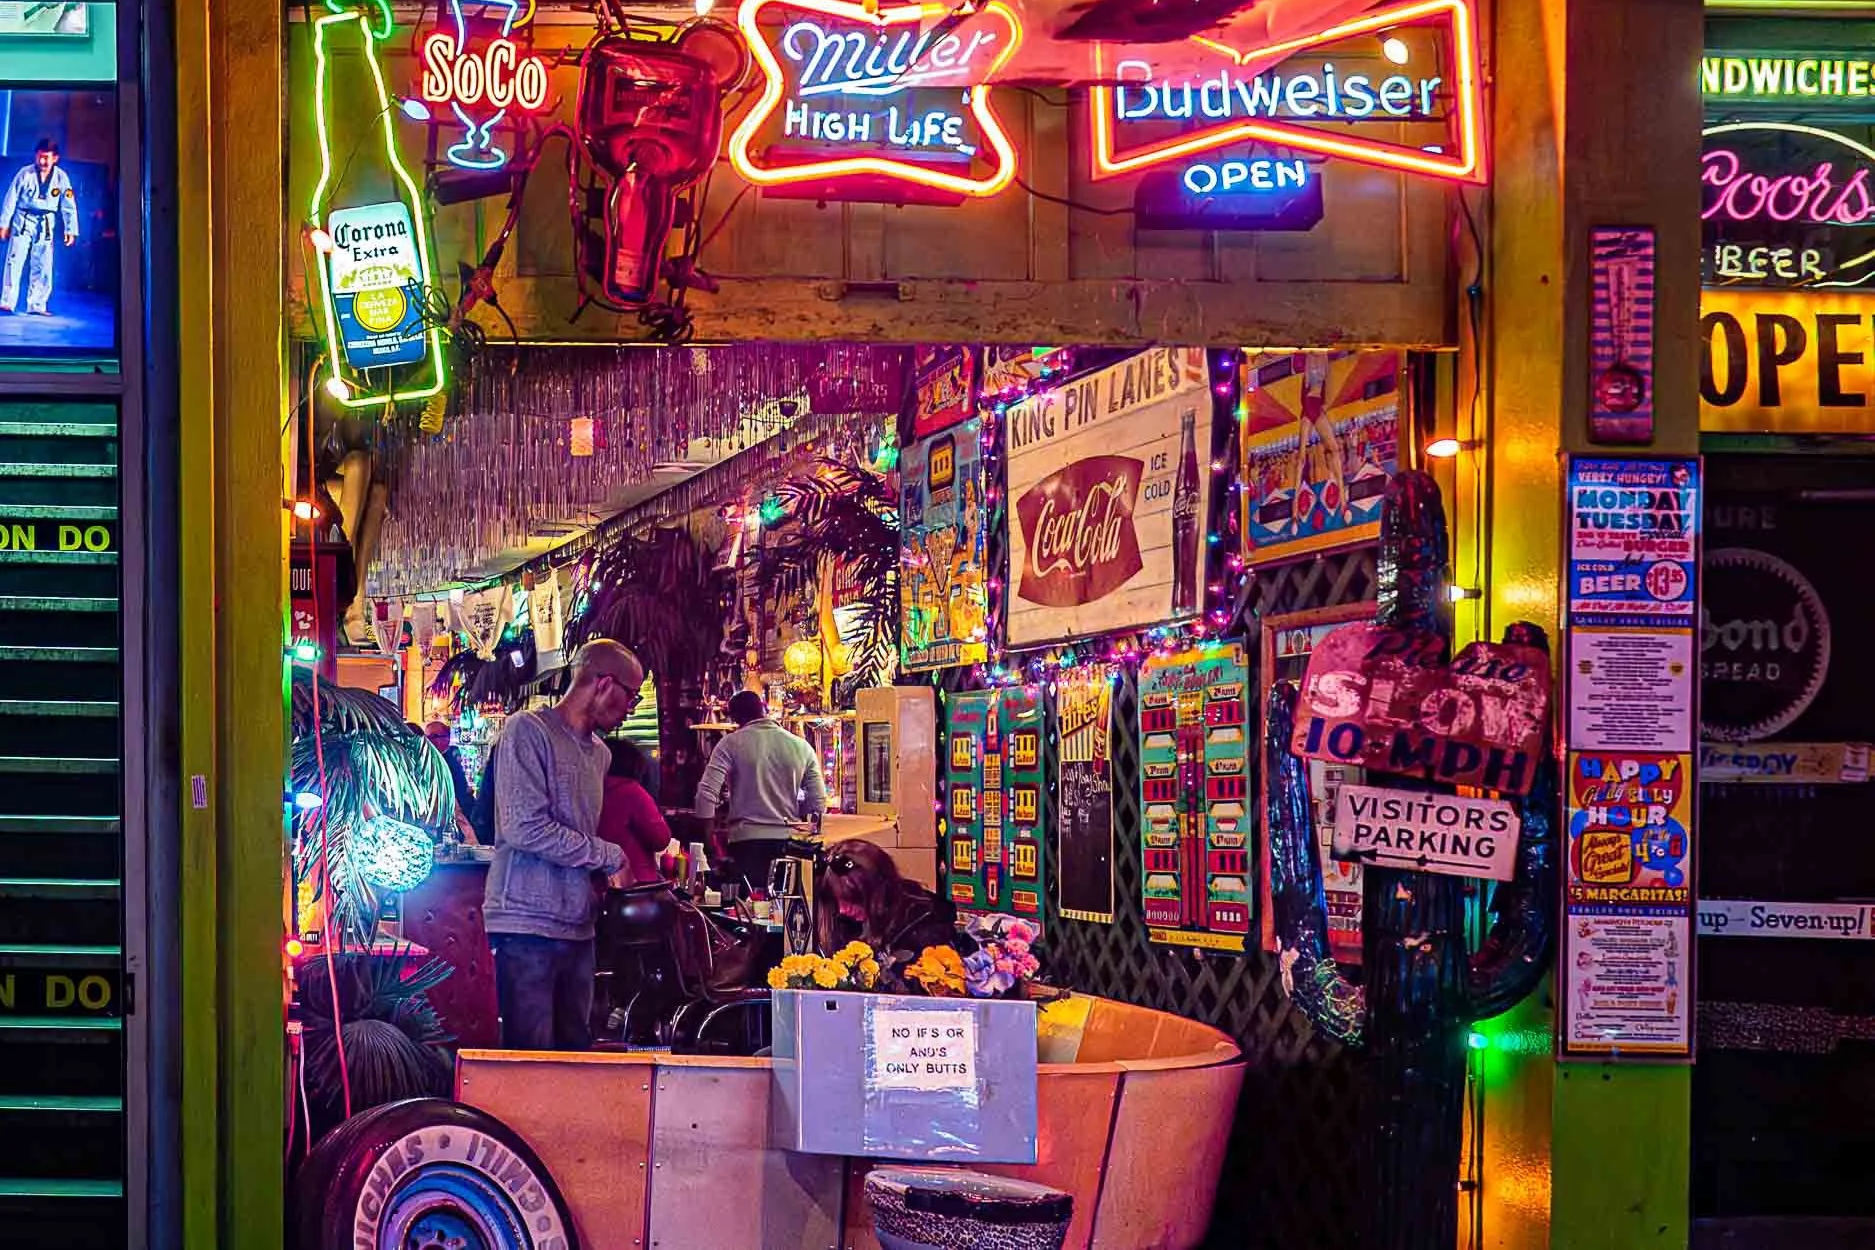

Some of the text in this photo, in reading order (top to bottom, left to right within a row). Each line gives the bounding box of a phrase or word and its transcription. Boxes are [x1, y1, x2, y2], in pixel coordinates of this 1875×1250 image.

[423, 33, 548, 110] SoCo
[783, 21, 997, 94] Miller
[1116, 60, 1442, 121] Budweiser
[1700, 57, 1875, 96] NDWICHE
[784, 100, 870, 143] HIGH
[1183, 159, 1307, 193] OPEN
[334, 220, 408, 251] Corona
[353, 246, 400, 262] Extra
[1715, 245, 1828, 279] BEER
[1699, 310, 1875, 408] OPE
[1011, 348, 1180, 450] KING PIN LANES
[1150, 453, 1168, 471] ICE
[1144, 480, 1171, 502] COLD
[1577, 489, 1691, 510] MONDAY
[1576, 512, 1691, 530] TUESDAY
[59, 525, 110, 552] DO
[1579, 574, 1641, 596] BEER
[1305, 717, 1529, 793] 10 MPH
[1579, 757, 1680, 786] HAPPY
[1348, 794, 1510, 832] VISITORS
[1587, 805, 1667, 828] HOUR
[1353, 822, 1497, 860] PARKING
[46, 975, 111, 1009] DO
[892, 1027, 910, 1038] NO
[946, 1028, 965, 1039] OR
[886, 1063, 968, 1075] ONLY BUTTS
